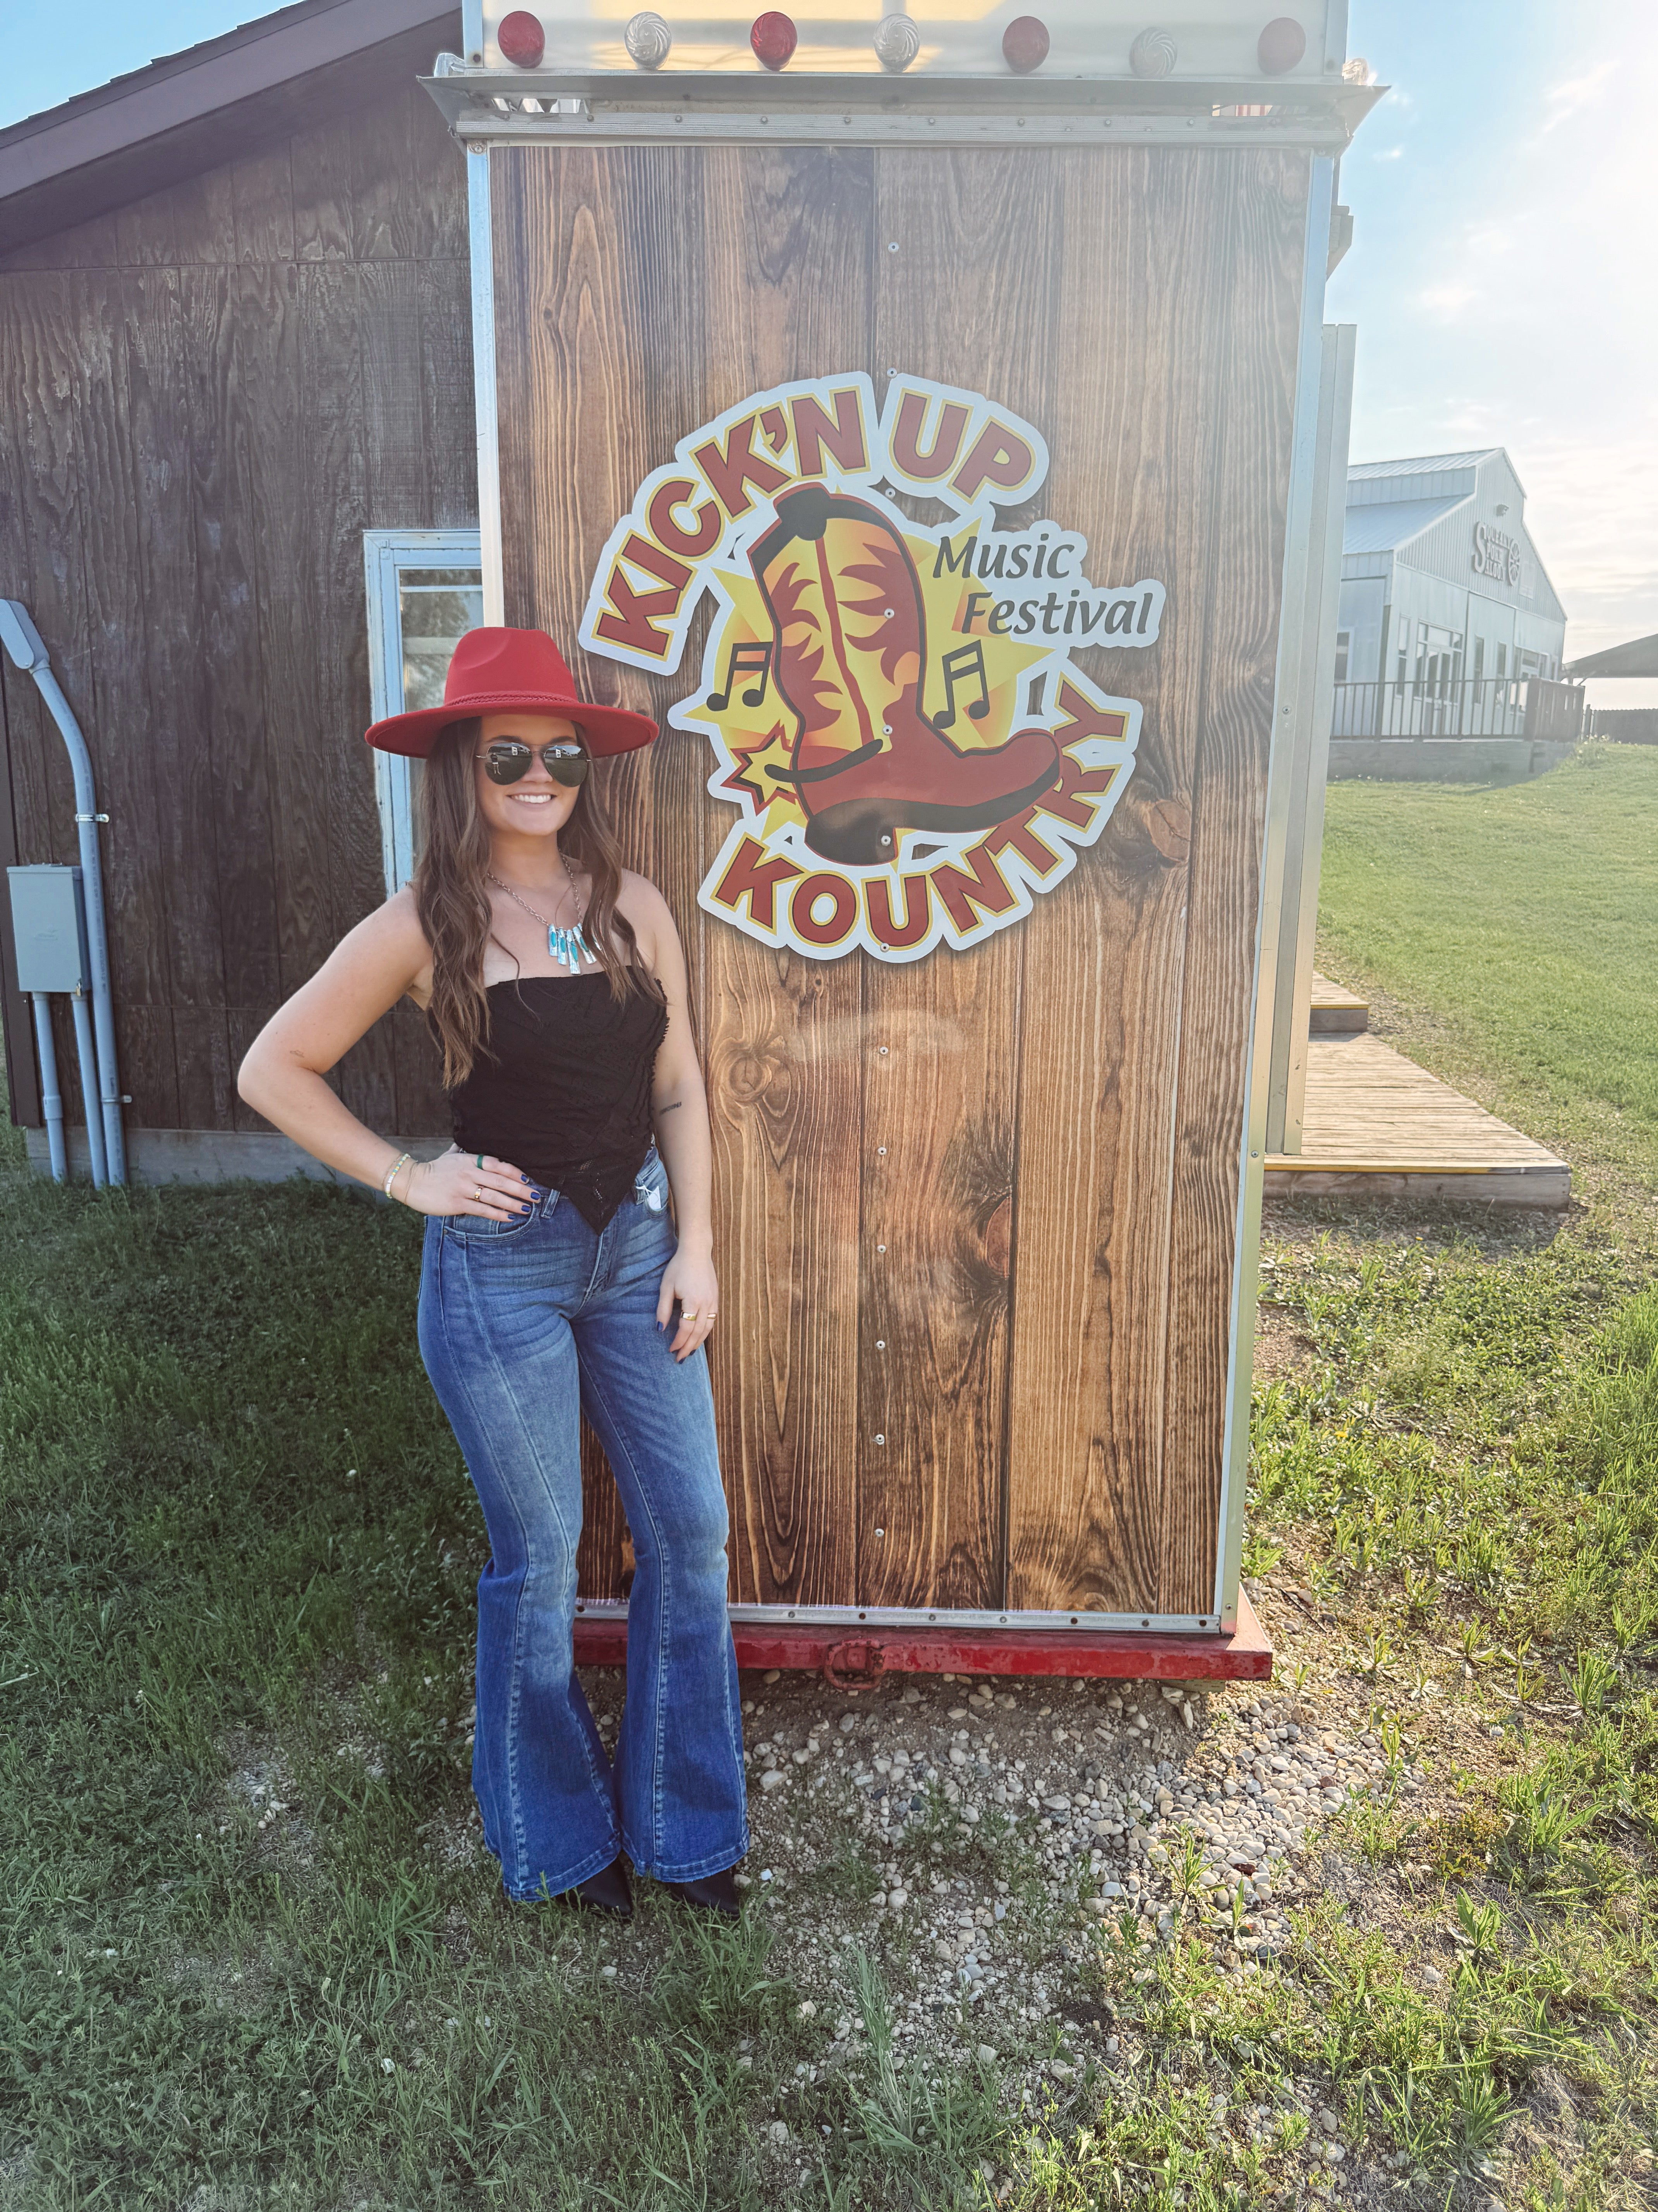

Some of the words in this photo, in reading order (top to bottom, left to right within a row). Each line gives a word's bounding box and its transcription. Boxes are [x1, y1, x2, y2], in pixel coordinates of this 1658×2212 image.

[591, 385, 870, 661] KICK'N
[889, 388, 1037, 505] UP
[932, 535, 1075, 579] Music
[961, 591, 1154, 635] Festival
[710, 672, 1131, 951] KOUNTRY
